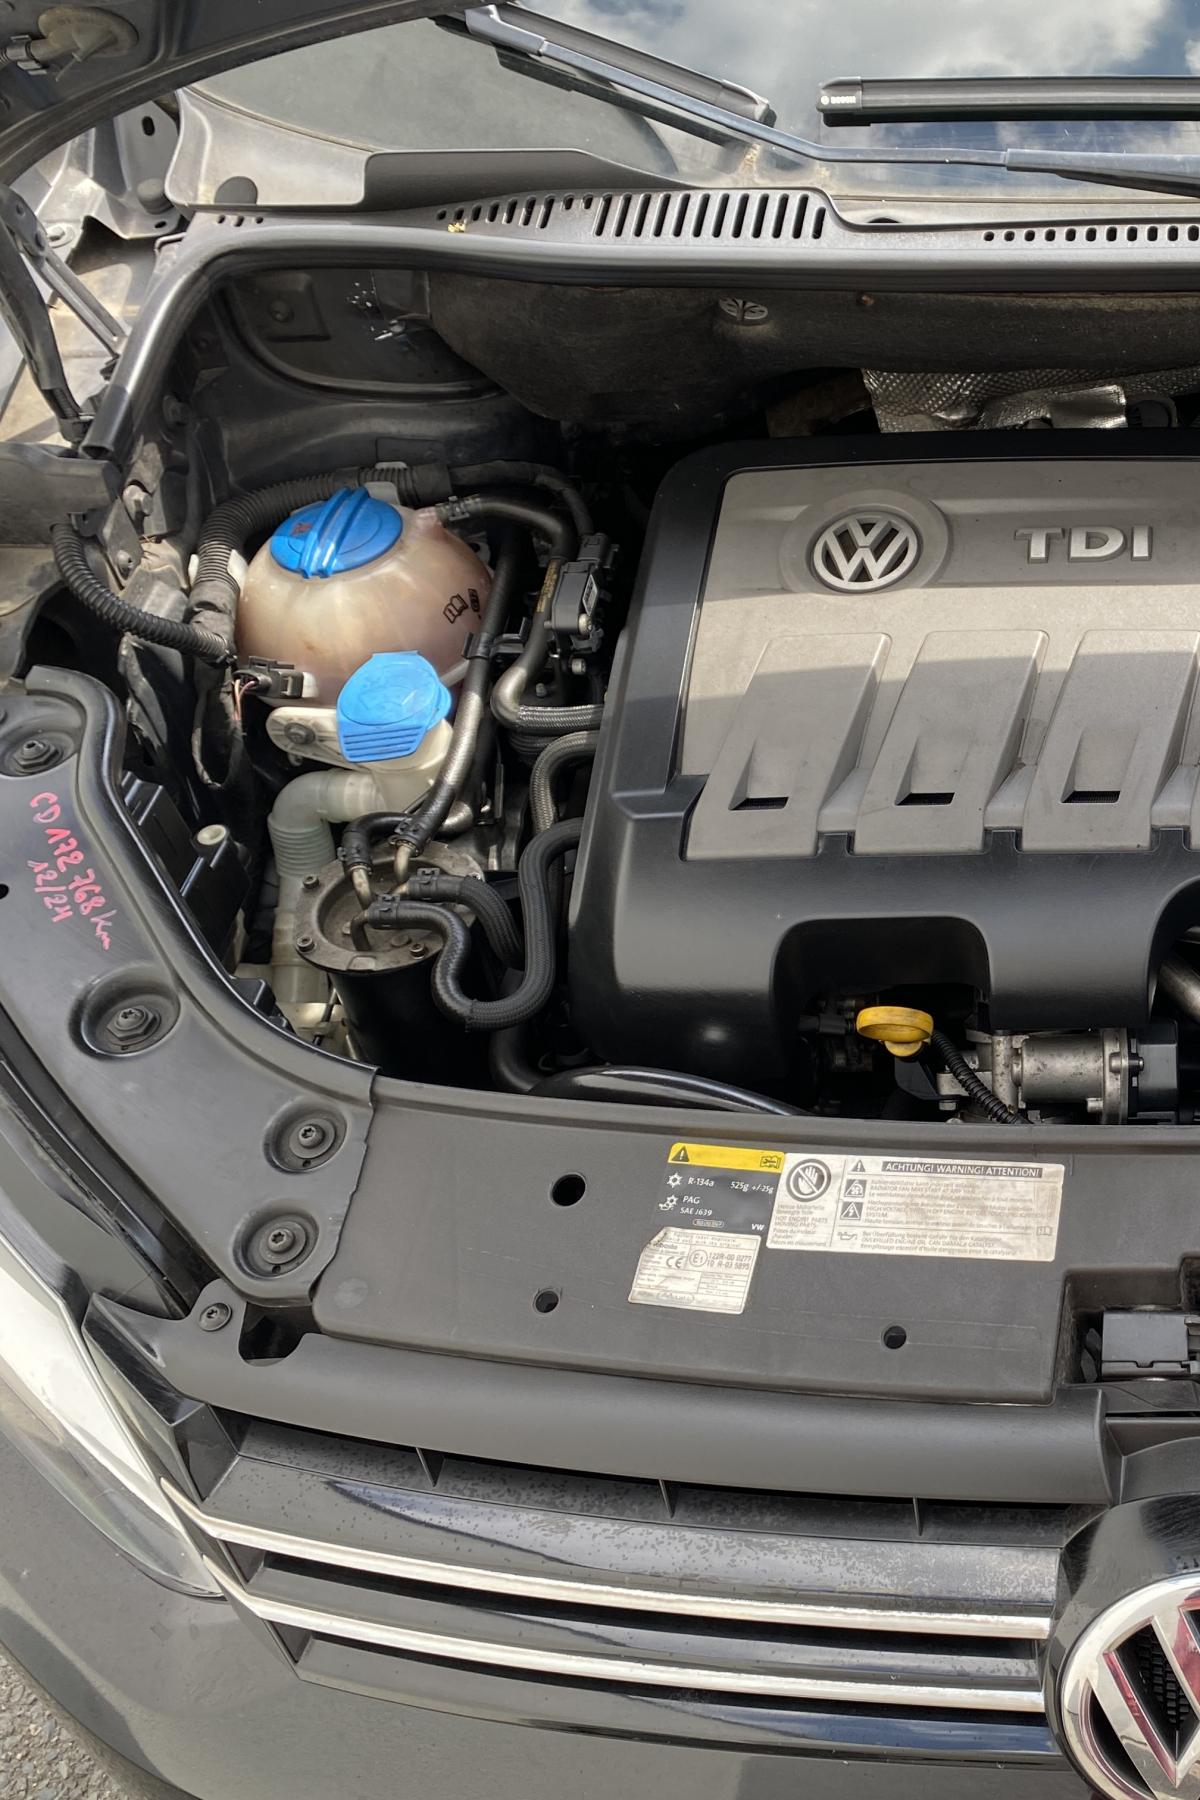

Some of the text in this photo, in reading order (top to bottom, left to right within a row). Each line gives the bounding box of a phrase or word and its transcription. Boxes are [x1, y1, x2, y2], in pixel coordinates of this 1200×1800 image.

[1014, 525, 1154, 564] TDI
[44, 828, 84, 872] 172
[68, 868, 106, 916] 768
[886, 1162, 1040, 1177] ACHTUNG! WARNING! ATTENTION!
[687, 1176, 715, 1187] R-134a
[730, 1181, 749, 1193] 525g
[682, 1195, 701, 1205] PAG
[680, 1207, 713, 1217] SAE J639
[751, 1223, 765, 1231] VW
